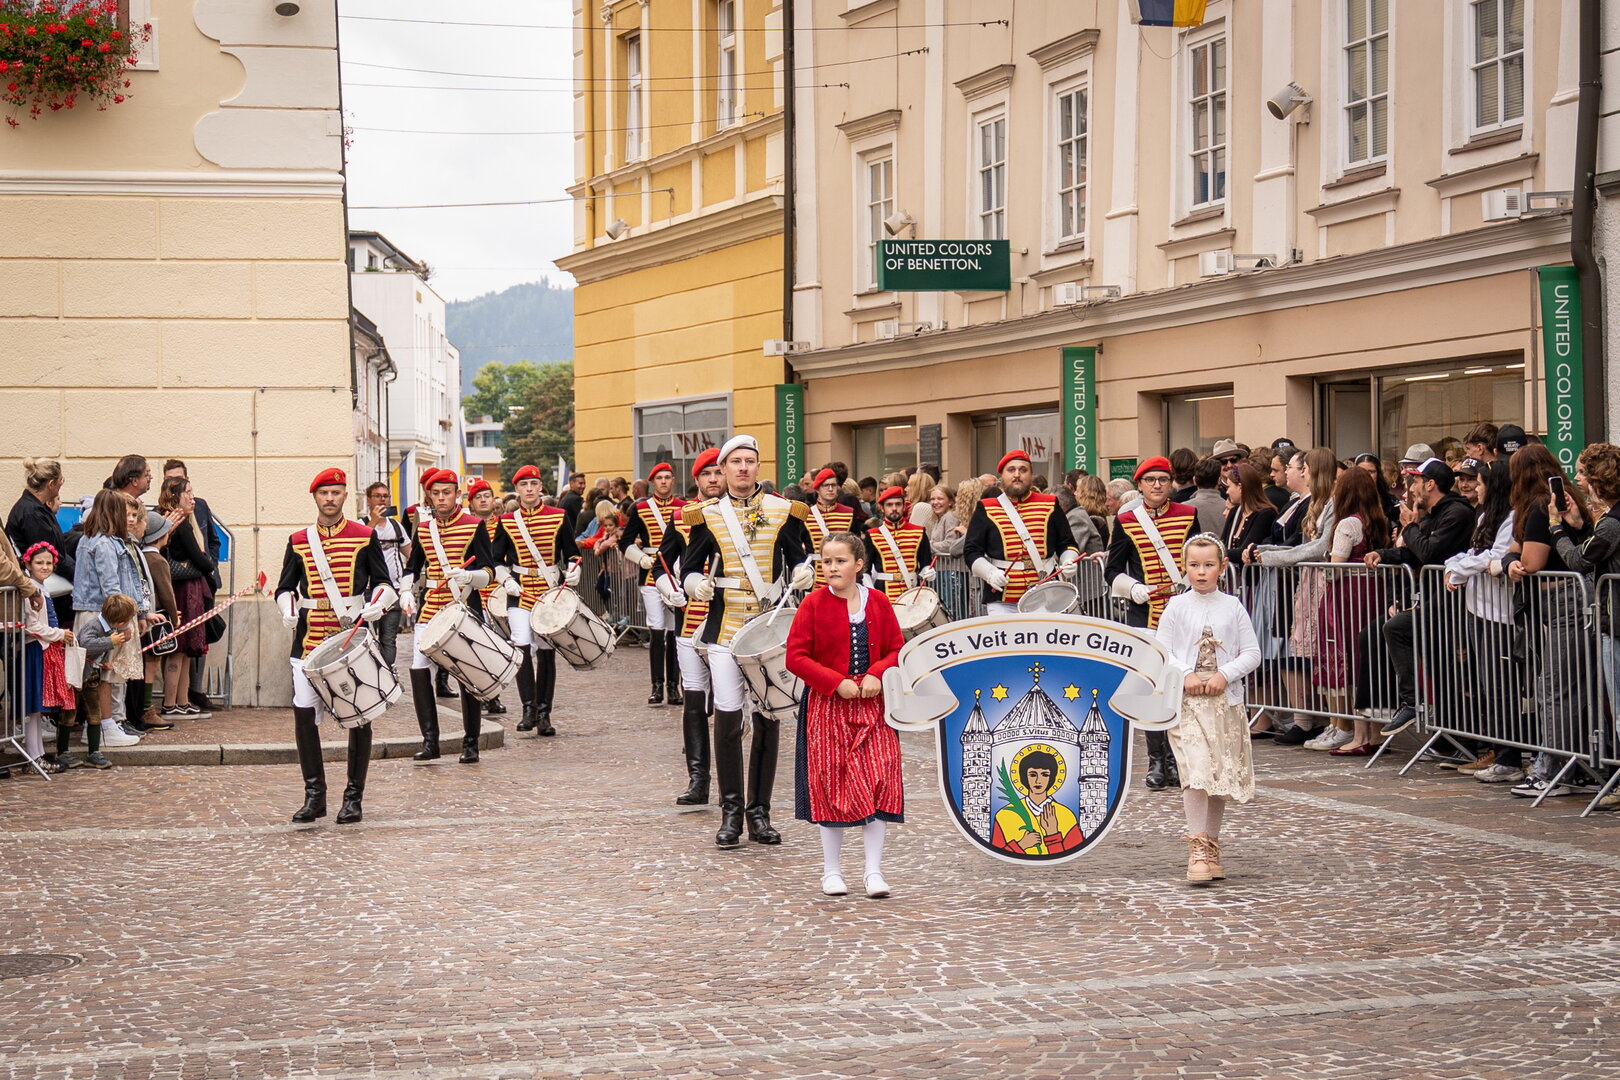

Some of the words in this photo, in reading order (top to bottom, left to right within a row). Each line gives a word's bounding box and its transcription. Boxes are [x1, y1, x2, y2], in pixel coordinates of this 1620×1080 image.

[885, 243, 935, 256] UNITED
[938, 243, 992, 256] COLORS
[885, 258, 904, 271] OF
[908, 258, 982, 271] BENETTON.
[1554, 284, 1570, 357] UNITED
[1073, 359, 1086, 411] UNITED
[1556, 363, 1573, 442] COLORS
[785, 393, 795, 434] UNITED
[786, 436, 797, 480] COLORS
[1074, 415, 1087, 471] COLORS
[1558, 447, 1573, 474] OF
[934, 640, 964, 660] St.
[967, 629, 1008, 650] Veit
[1014, 630, 1039, 645] an
[1045, 628, 1081, 646] der
[1086, 632, 1134, 658] Glan
